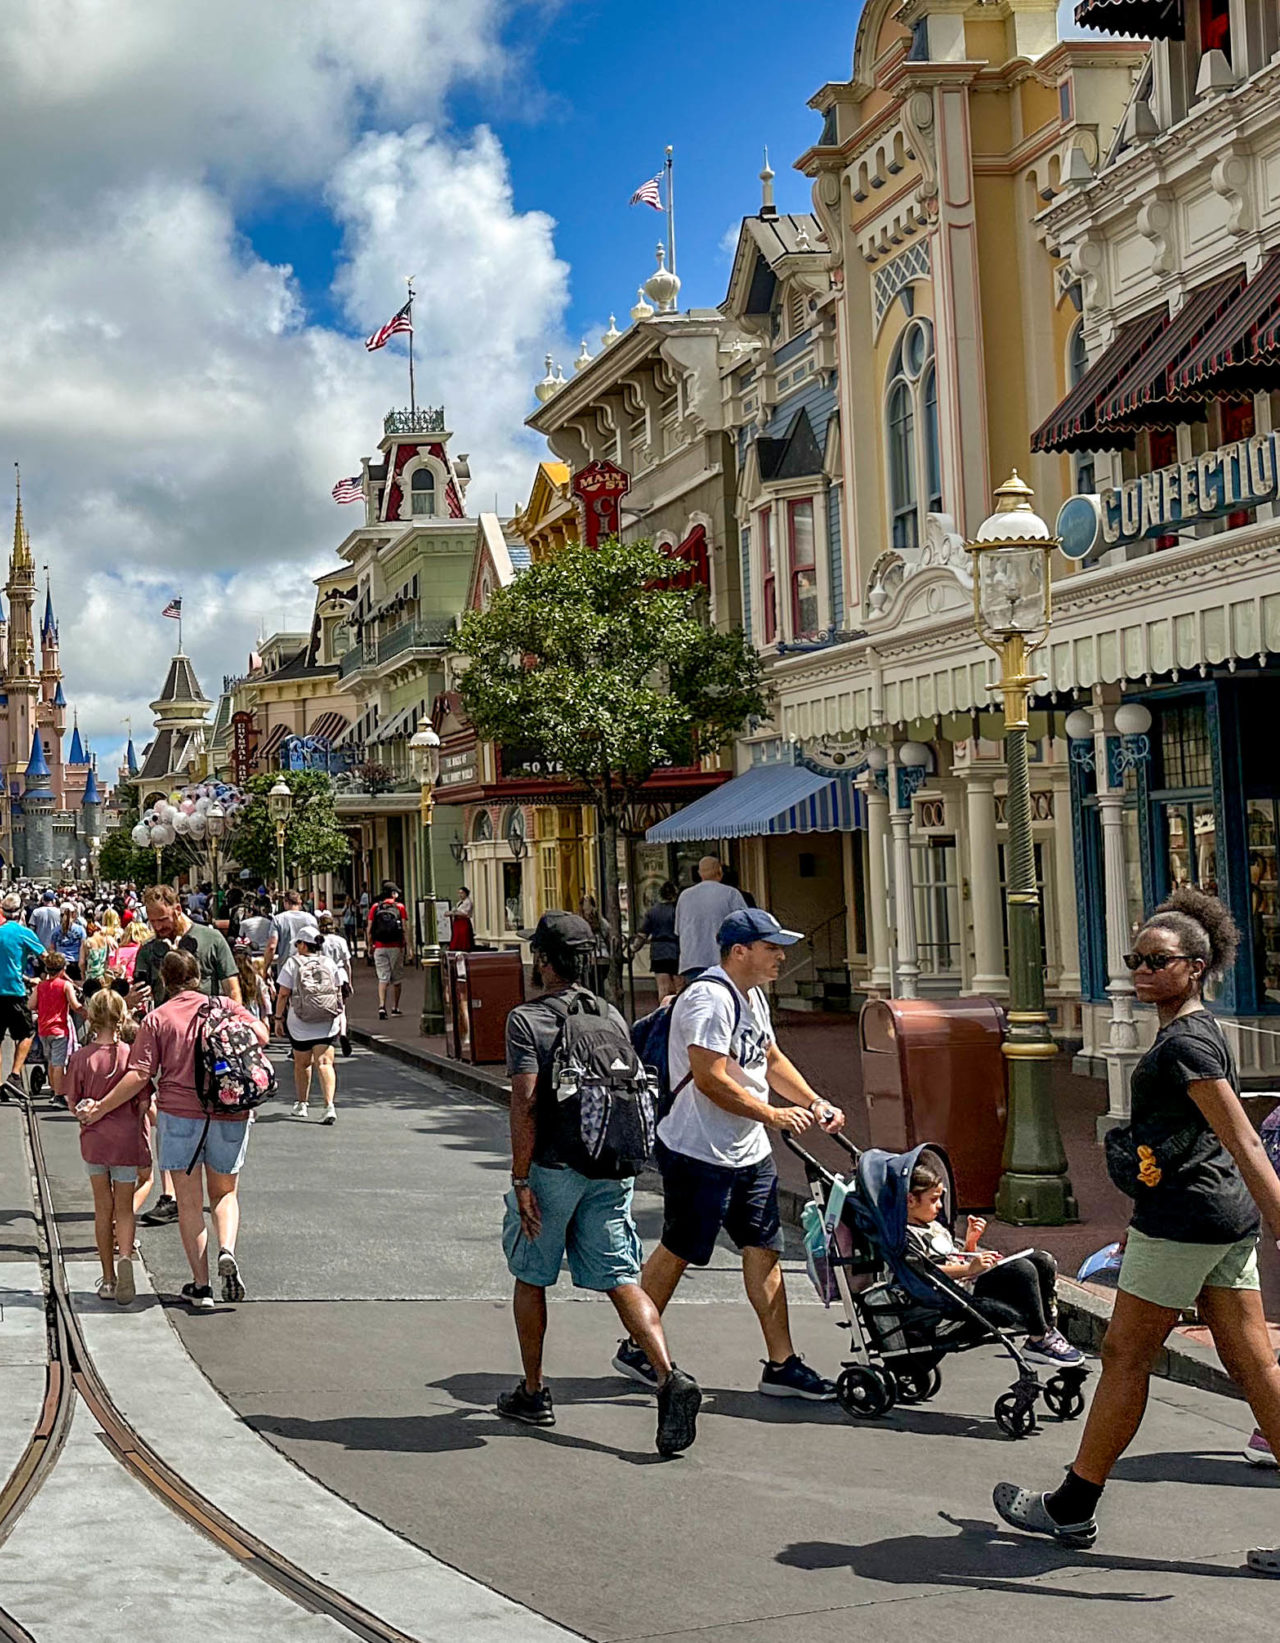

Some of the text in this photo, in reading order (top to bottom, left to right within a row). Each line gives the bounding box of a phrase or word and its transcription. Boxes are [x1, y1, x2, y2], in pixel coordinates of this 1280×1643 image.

[580, 473, 622, 489] MAIN
[1100, 429, 1280, 543] CONFECTIO
[522, 761, 541, 773] 50
